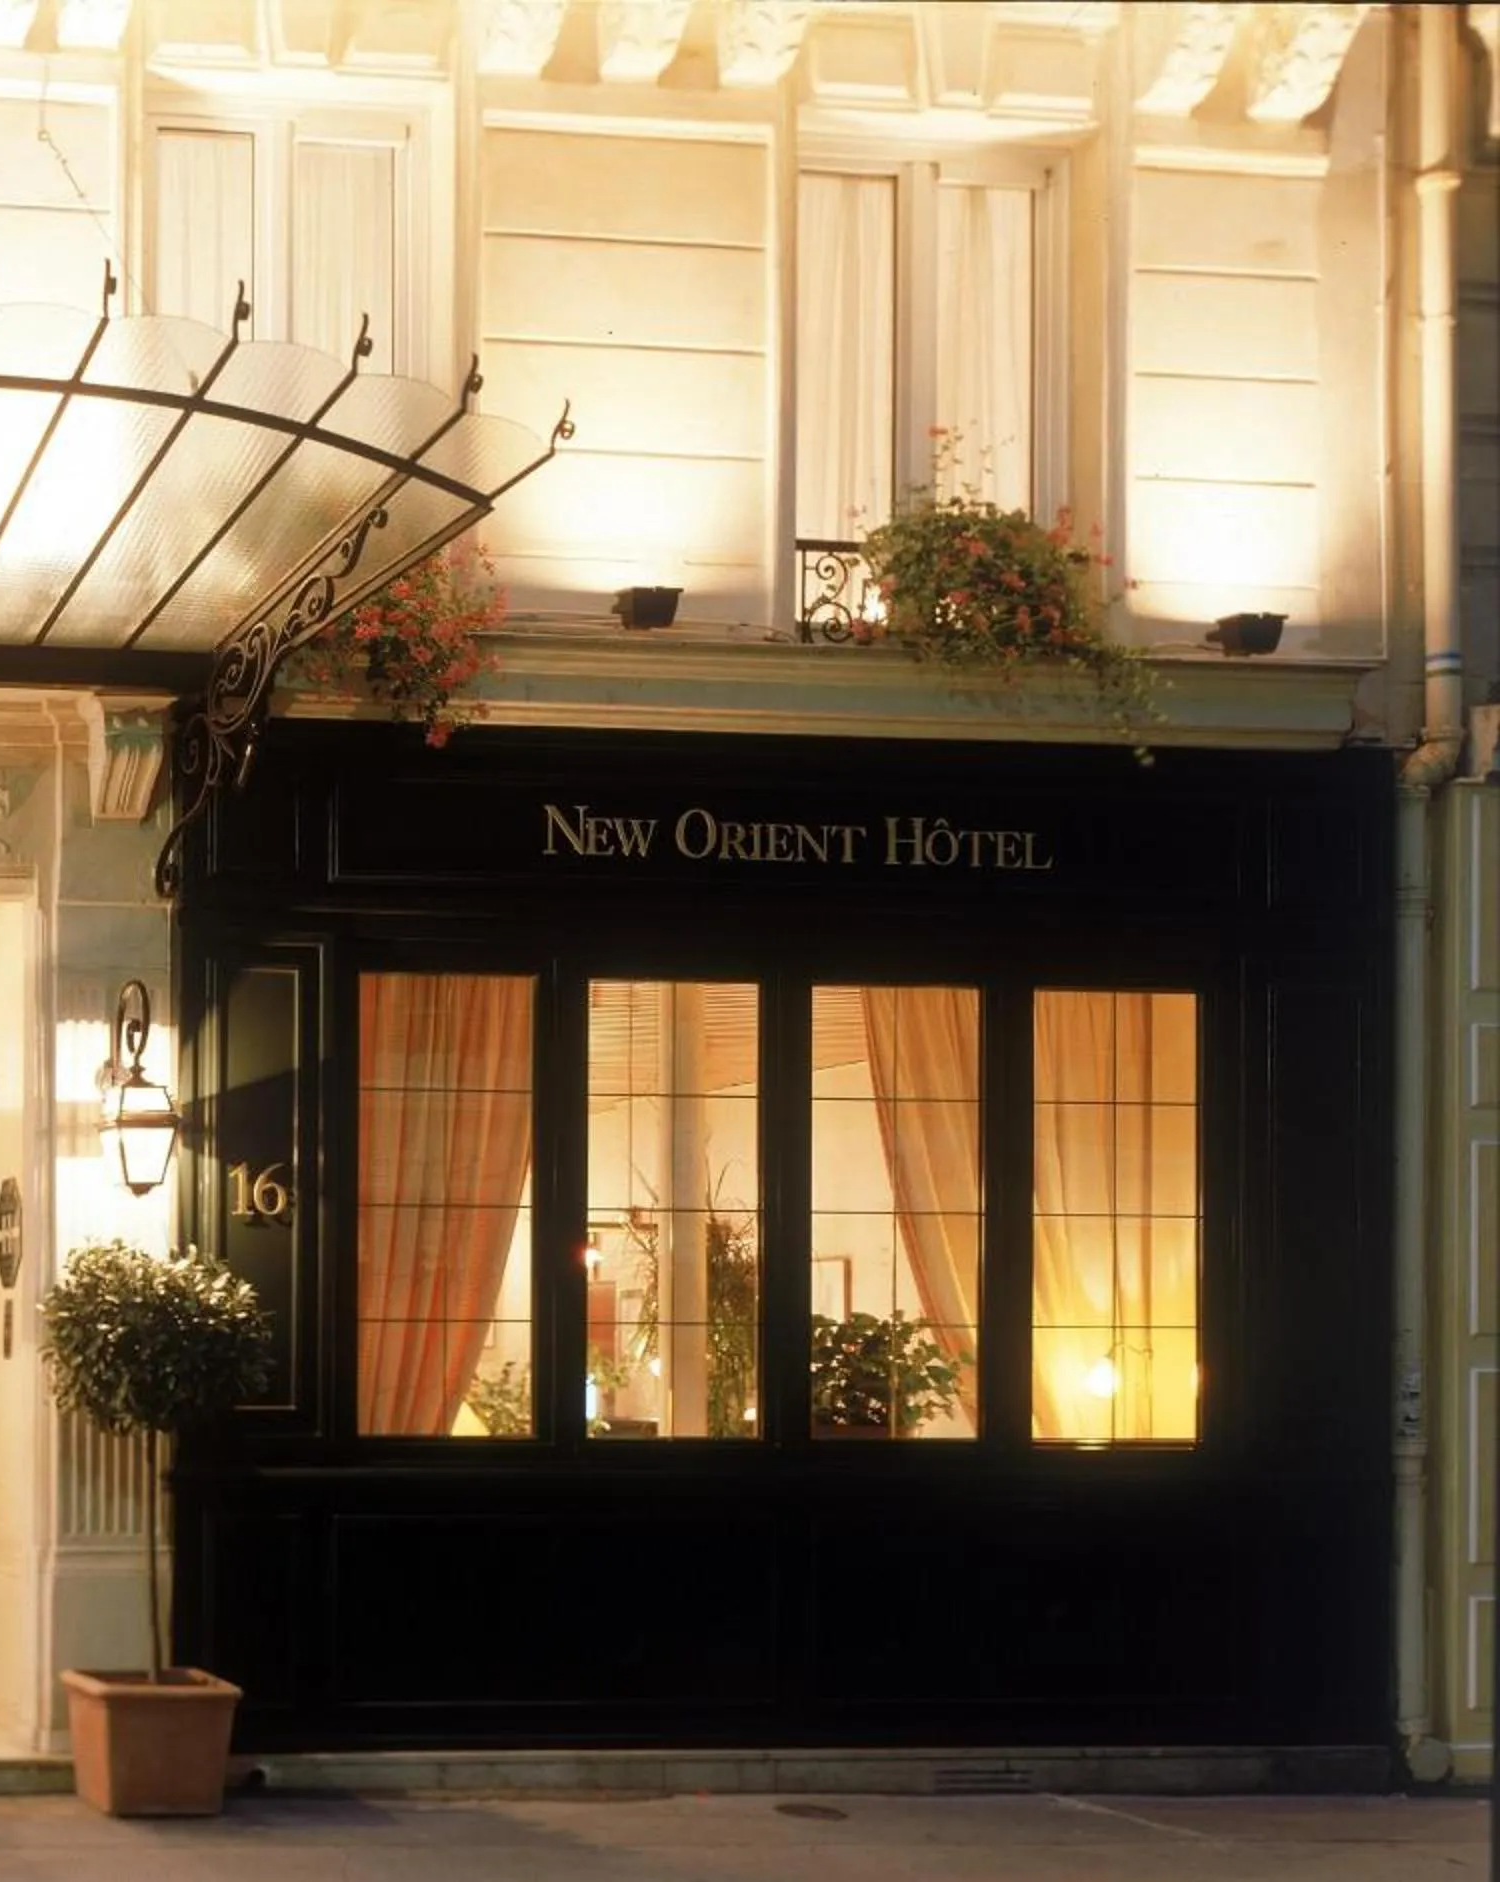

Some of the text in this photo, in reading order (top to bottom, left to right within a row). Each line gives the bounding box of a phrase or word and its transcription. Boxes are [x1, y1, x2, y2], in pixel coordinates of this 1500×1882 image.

[541, 804, 1053, 870] NEW ORIENT HÔTEL
[228, 1161, 288, 1216] 16
